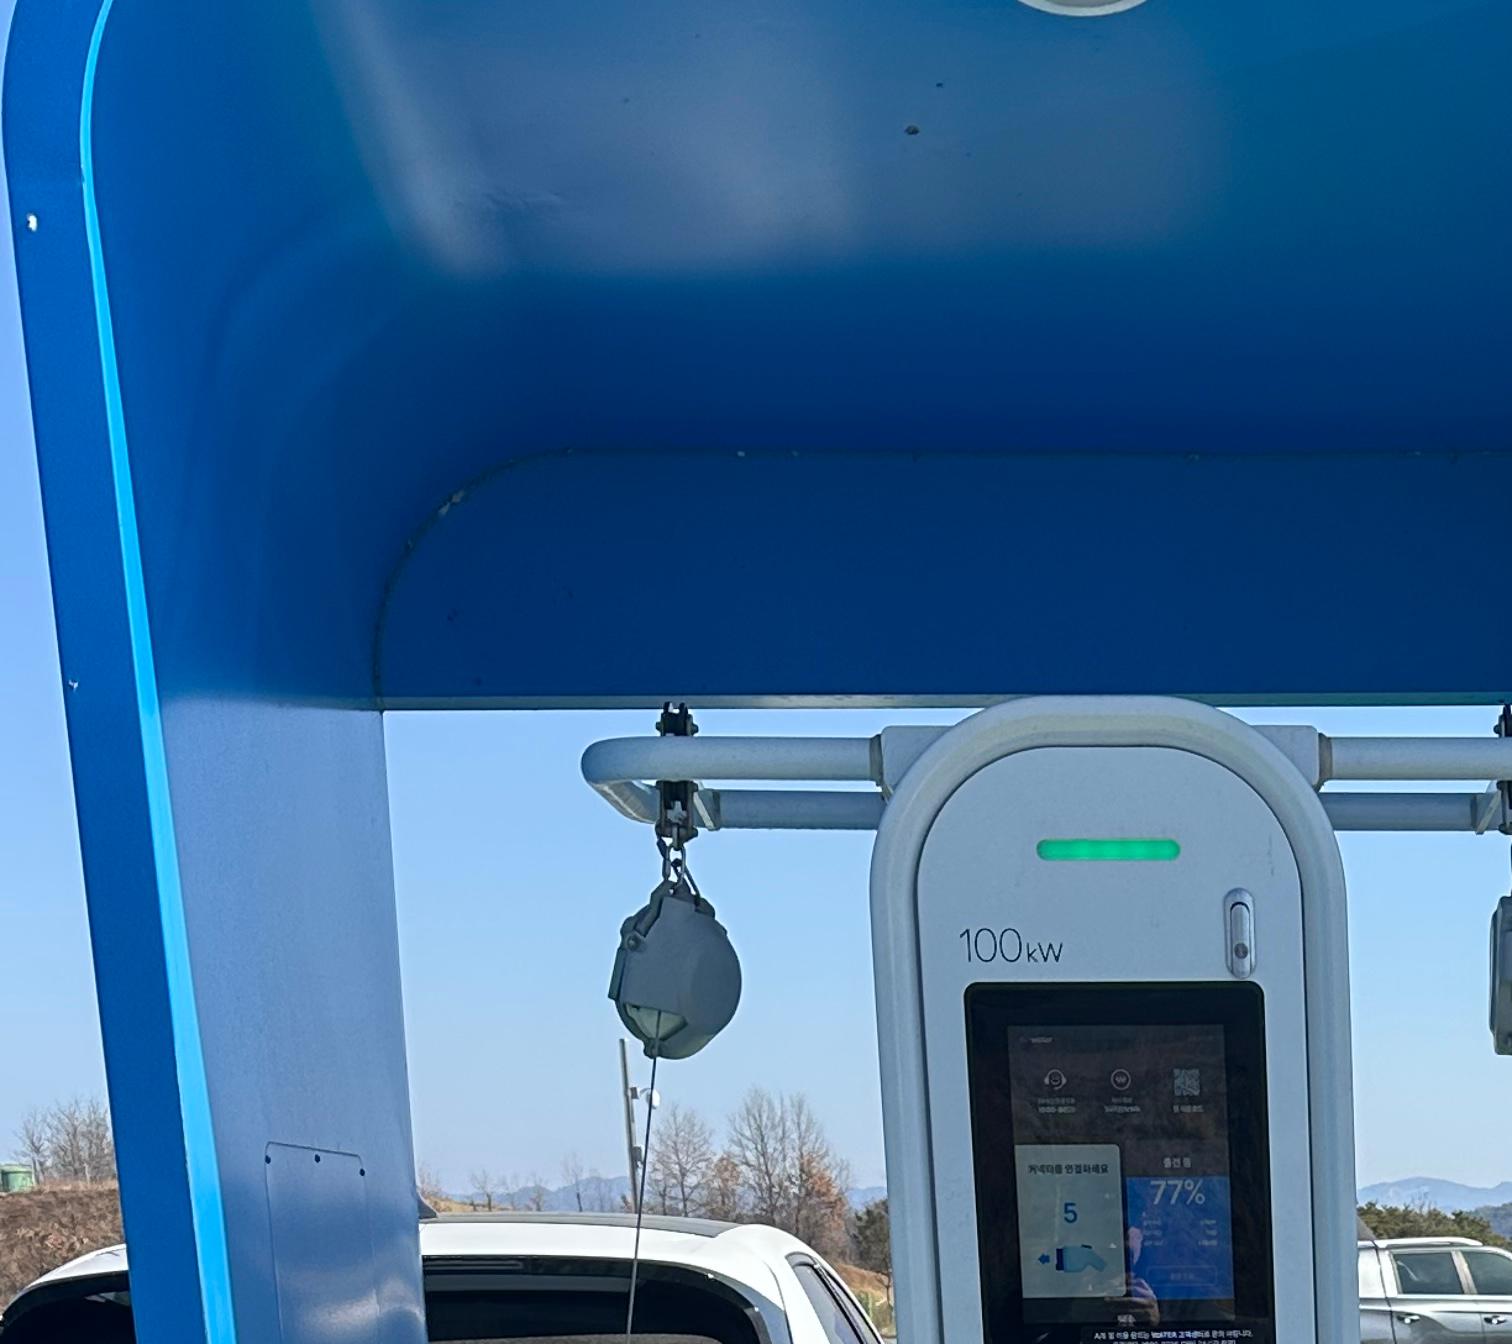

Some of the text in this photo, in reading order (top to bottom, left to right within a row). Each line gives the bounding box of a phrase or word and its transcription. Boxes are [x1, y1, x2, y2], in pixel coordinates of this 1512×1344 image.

[959, 927, 1063, 963] 100kW
[1150, 1179, 1206, 1205] 77%
[1063, 1202, 1078, 1224] 5
